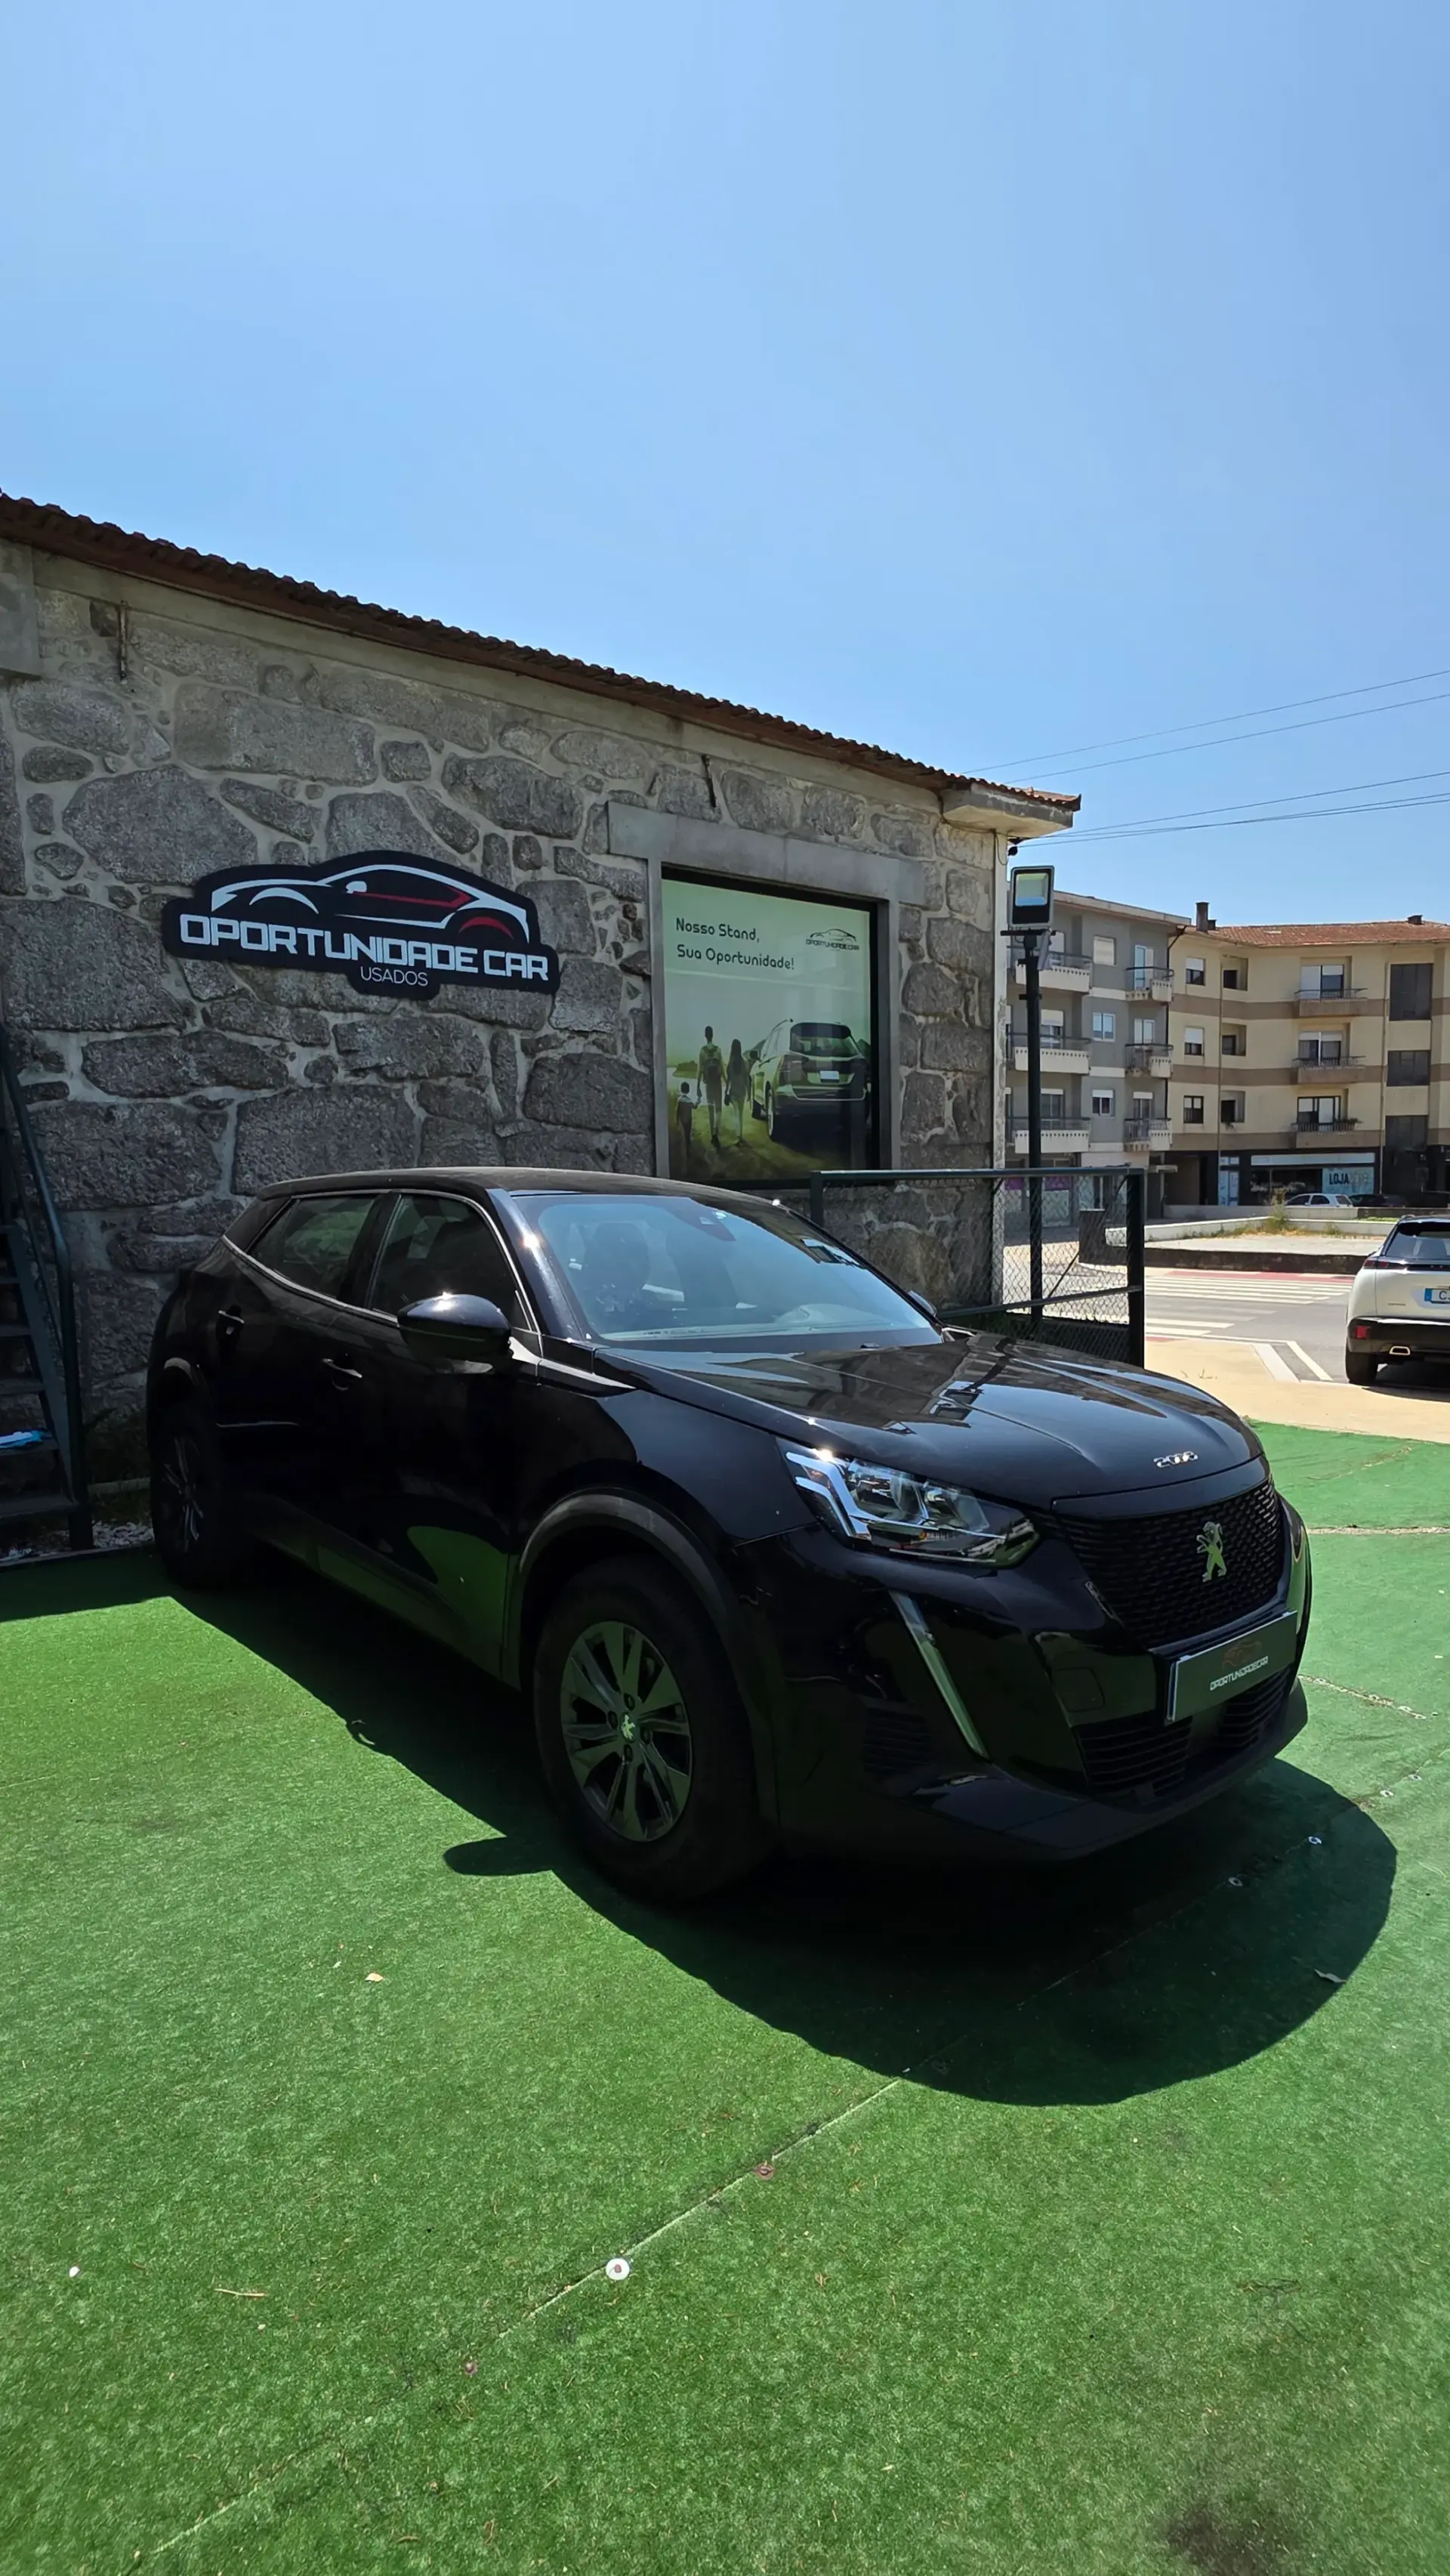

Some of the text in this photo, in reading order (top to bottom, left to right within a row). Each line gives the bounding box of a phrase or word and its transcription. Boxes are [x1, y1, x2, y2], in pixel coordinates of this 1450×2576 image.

[676, 917, 760, 943] Nosso Stand,
[180, 913, 549, 981] OPORTUNIDADE CAR
[677, 944, 794, 970] Sua Oportunidade!
[360, 965, 428, 987] USADOS
[1439, 1290, 1450, 1301] C
